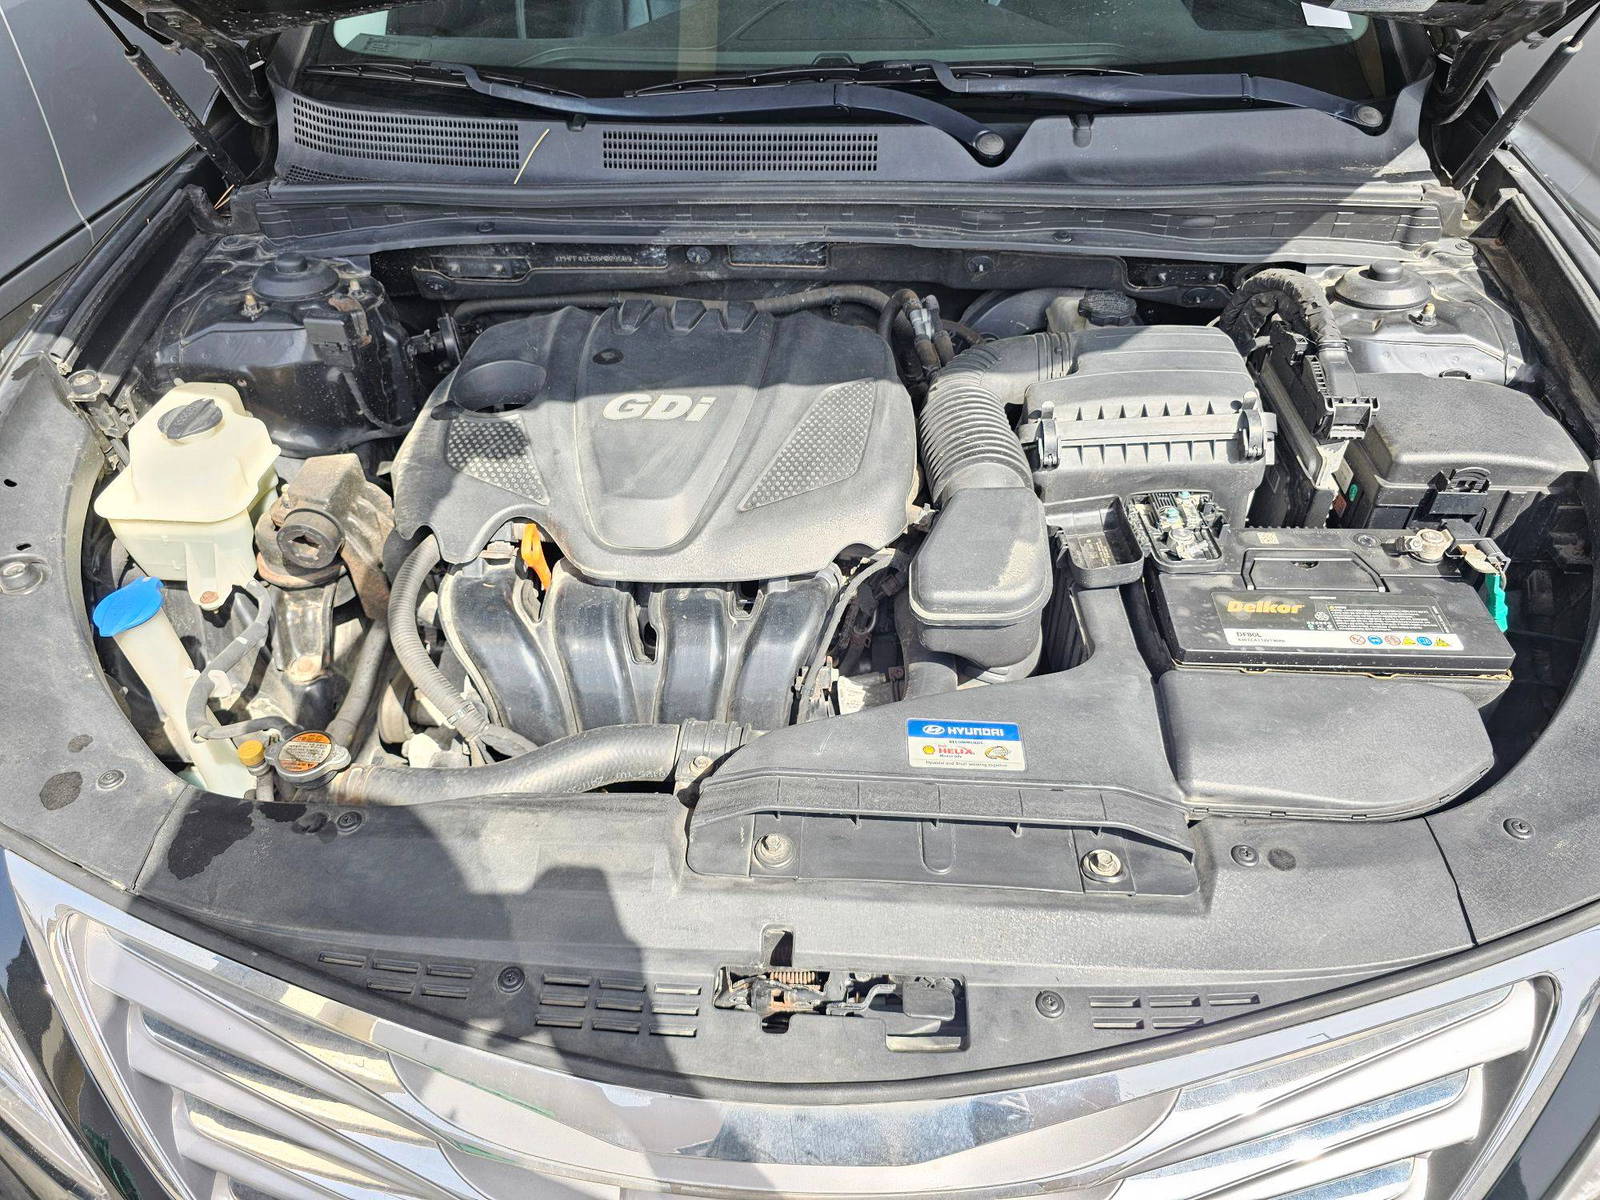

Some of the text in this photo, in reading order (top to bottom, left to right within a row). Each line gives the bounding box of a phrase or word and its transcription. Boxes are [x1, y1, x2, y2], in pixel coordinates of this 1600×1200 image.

[602, 393, 718, 422] GDi
[1227, 600, 1304, 614] Delkor
[947, 726, 1004, 737] HYUNDAI
